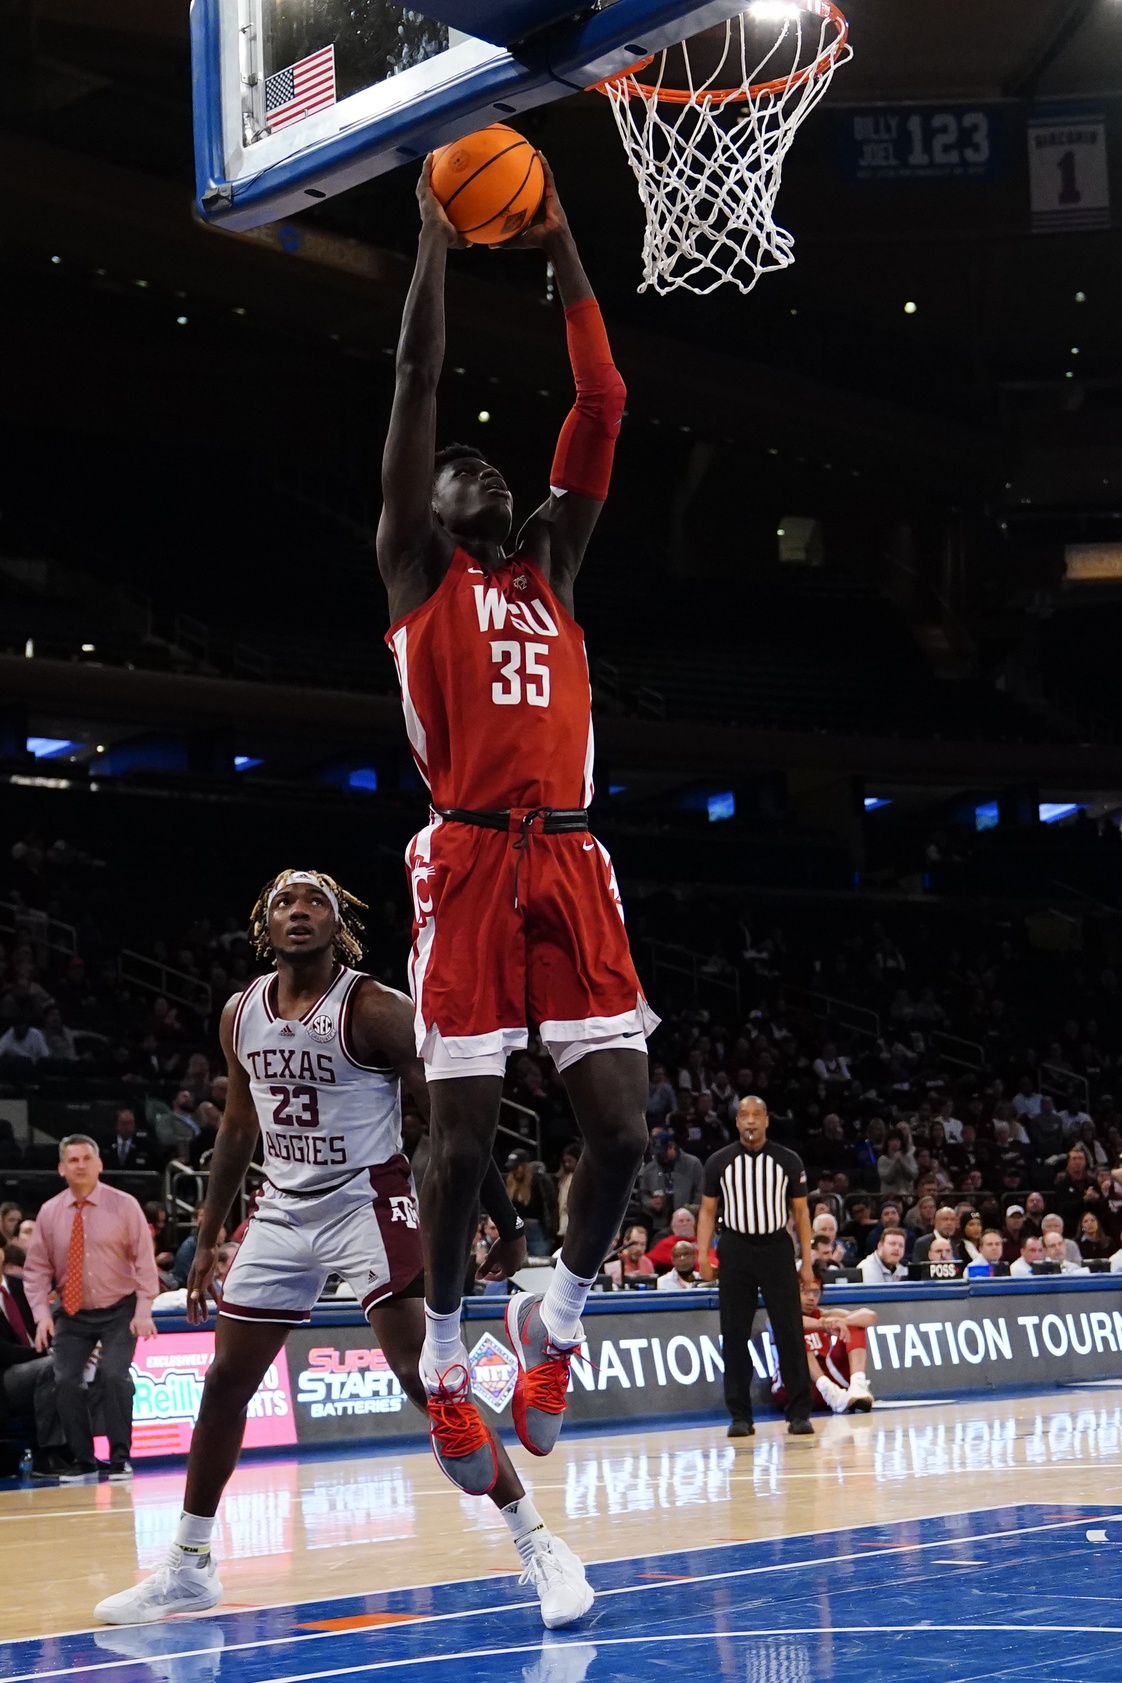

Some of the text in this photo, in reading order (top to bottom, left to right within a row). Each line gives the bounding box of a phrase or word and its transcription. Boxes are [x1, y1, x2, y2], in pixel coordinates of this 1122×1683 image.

[906, 111, 990, 165] 123
[1057, 151, 1082, 206] 1
[472, 585, 559, 637] WSU
[489, 640, 550, 708] 35
[313, 1016, 332, 1035] SEC
[247, 1049, 336, 1083] TEXAS
[269, 1086, 320, 1128] 23
[266, 1131, 347, 1166] AGGIES
[930, 1263, 957, 1278] POSS
[308, 1347, 391, 1373] SUPE
[475, 1364, 512, 1382] NIT
[297, 1370, 402, 1402] START
[311, 1399, 401, 1418] BATTERIES
